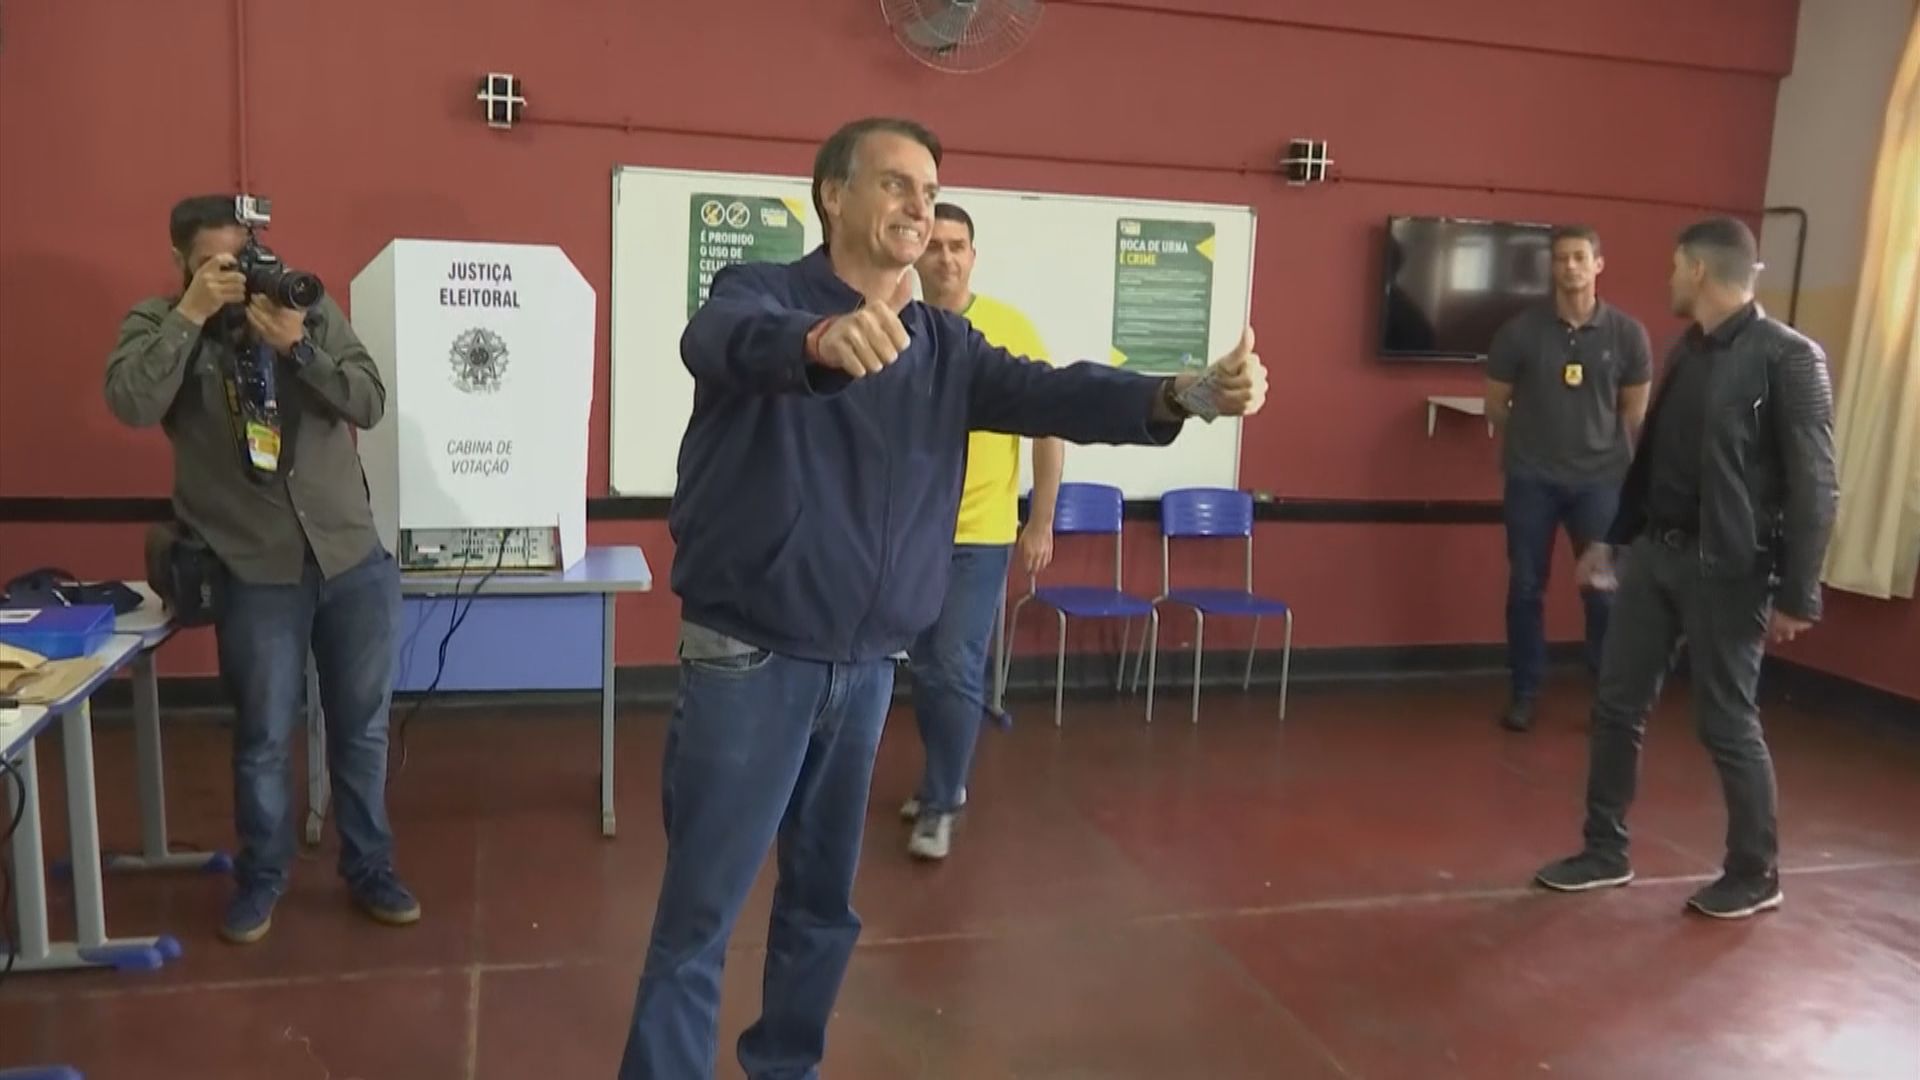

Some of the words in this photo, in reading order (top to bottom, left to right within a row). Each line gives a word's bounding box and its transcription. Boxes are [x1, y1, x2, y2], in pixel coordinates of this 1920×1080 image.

[708, 231, 754, 246] PROIBIDO
[700, 245, 707, 257] O
[708, 246, 729, 258] USO
[730, 247, 743, 259] DE
[448, 261, 512, 286] JUSTIÇA
[440, 287, 520, 309] ELEITORAL
[446, 439, 493, 456] CABINA
[496, 439, 512, 456] DE
[452, 457, 510, 477] VOTAÇÃO
